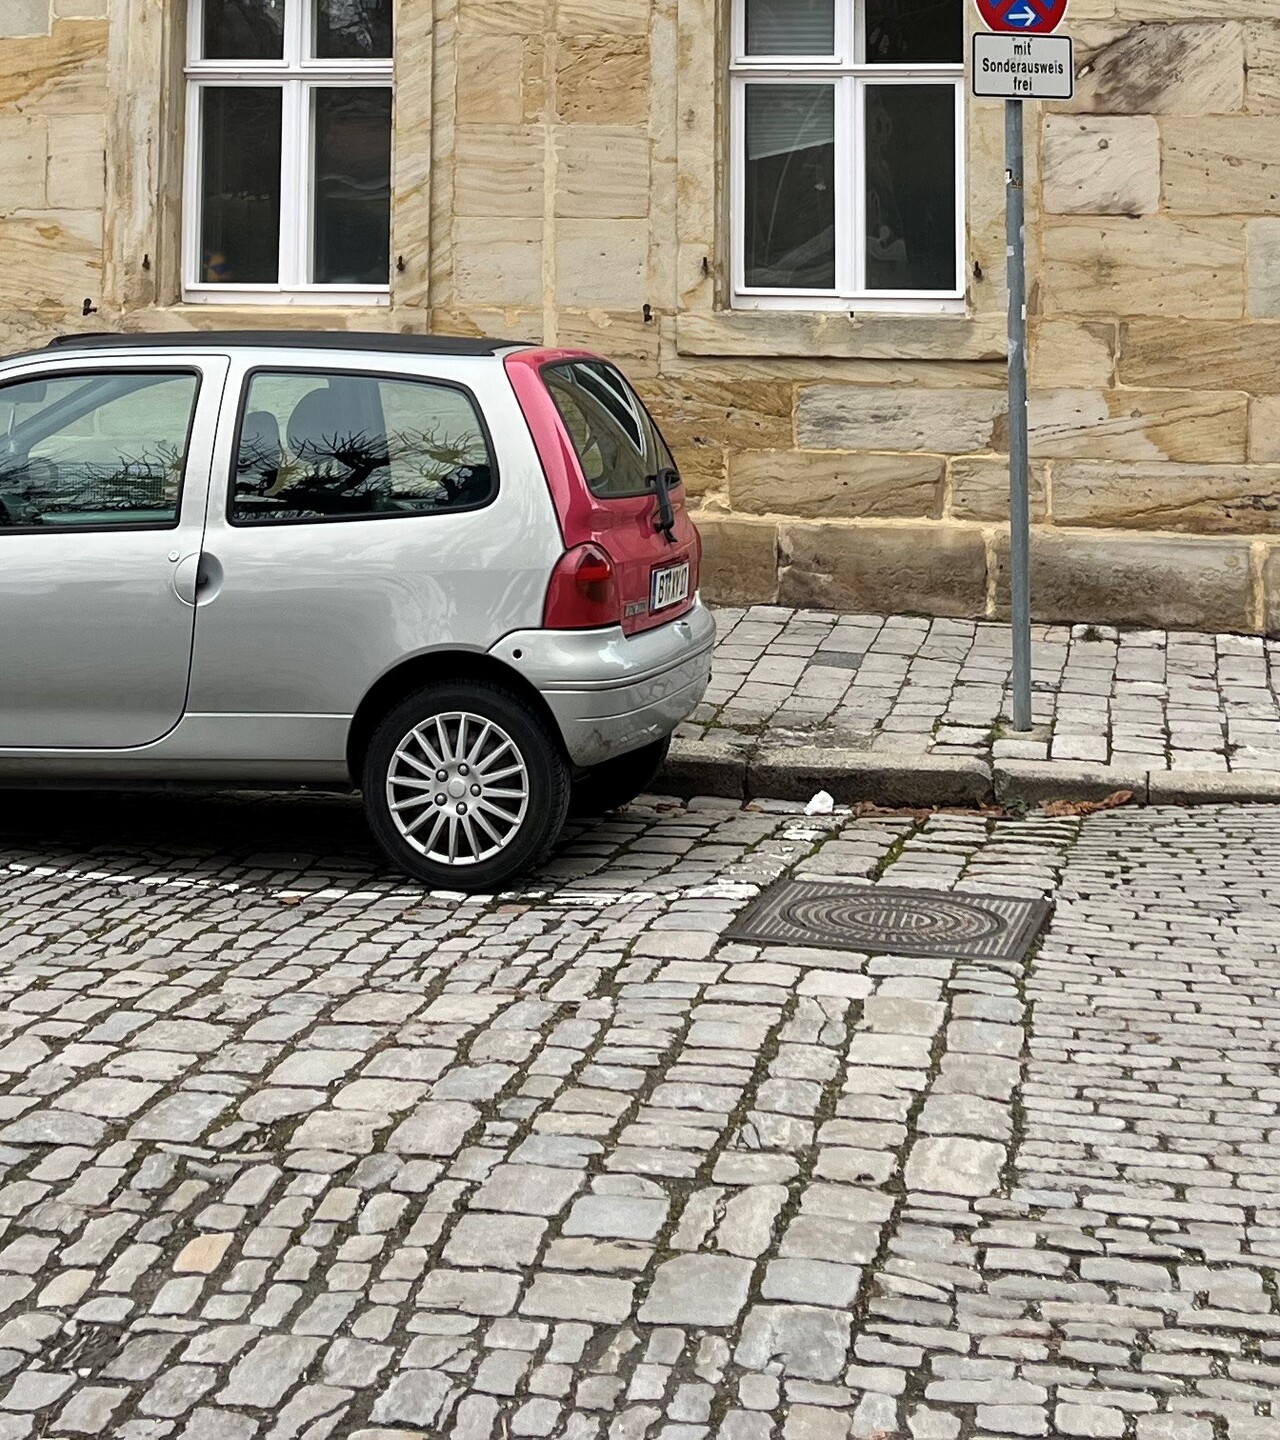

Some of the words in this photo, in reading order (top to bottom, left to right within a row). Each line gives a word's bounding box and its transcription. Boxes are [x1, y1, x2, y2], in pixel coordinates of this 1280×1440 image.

[1013, 41, 1032, 56] mit
[982, 57, 1064, 75] Sonderausweis
[1013, 76, 1032, 91] frei
